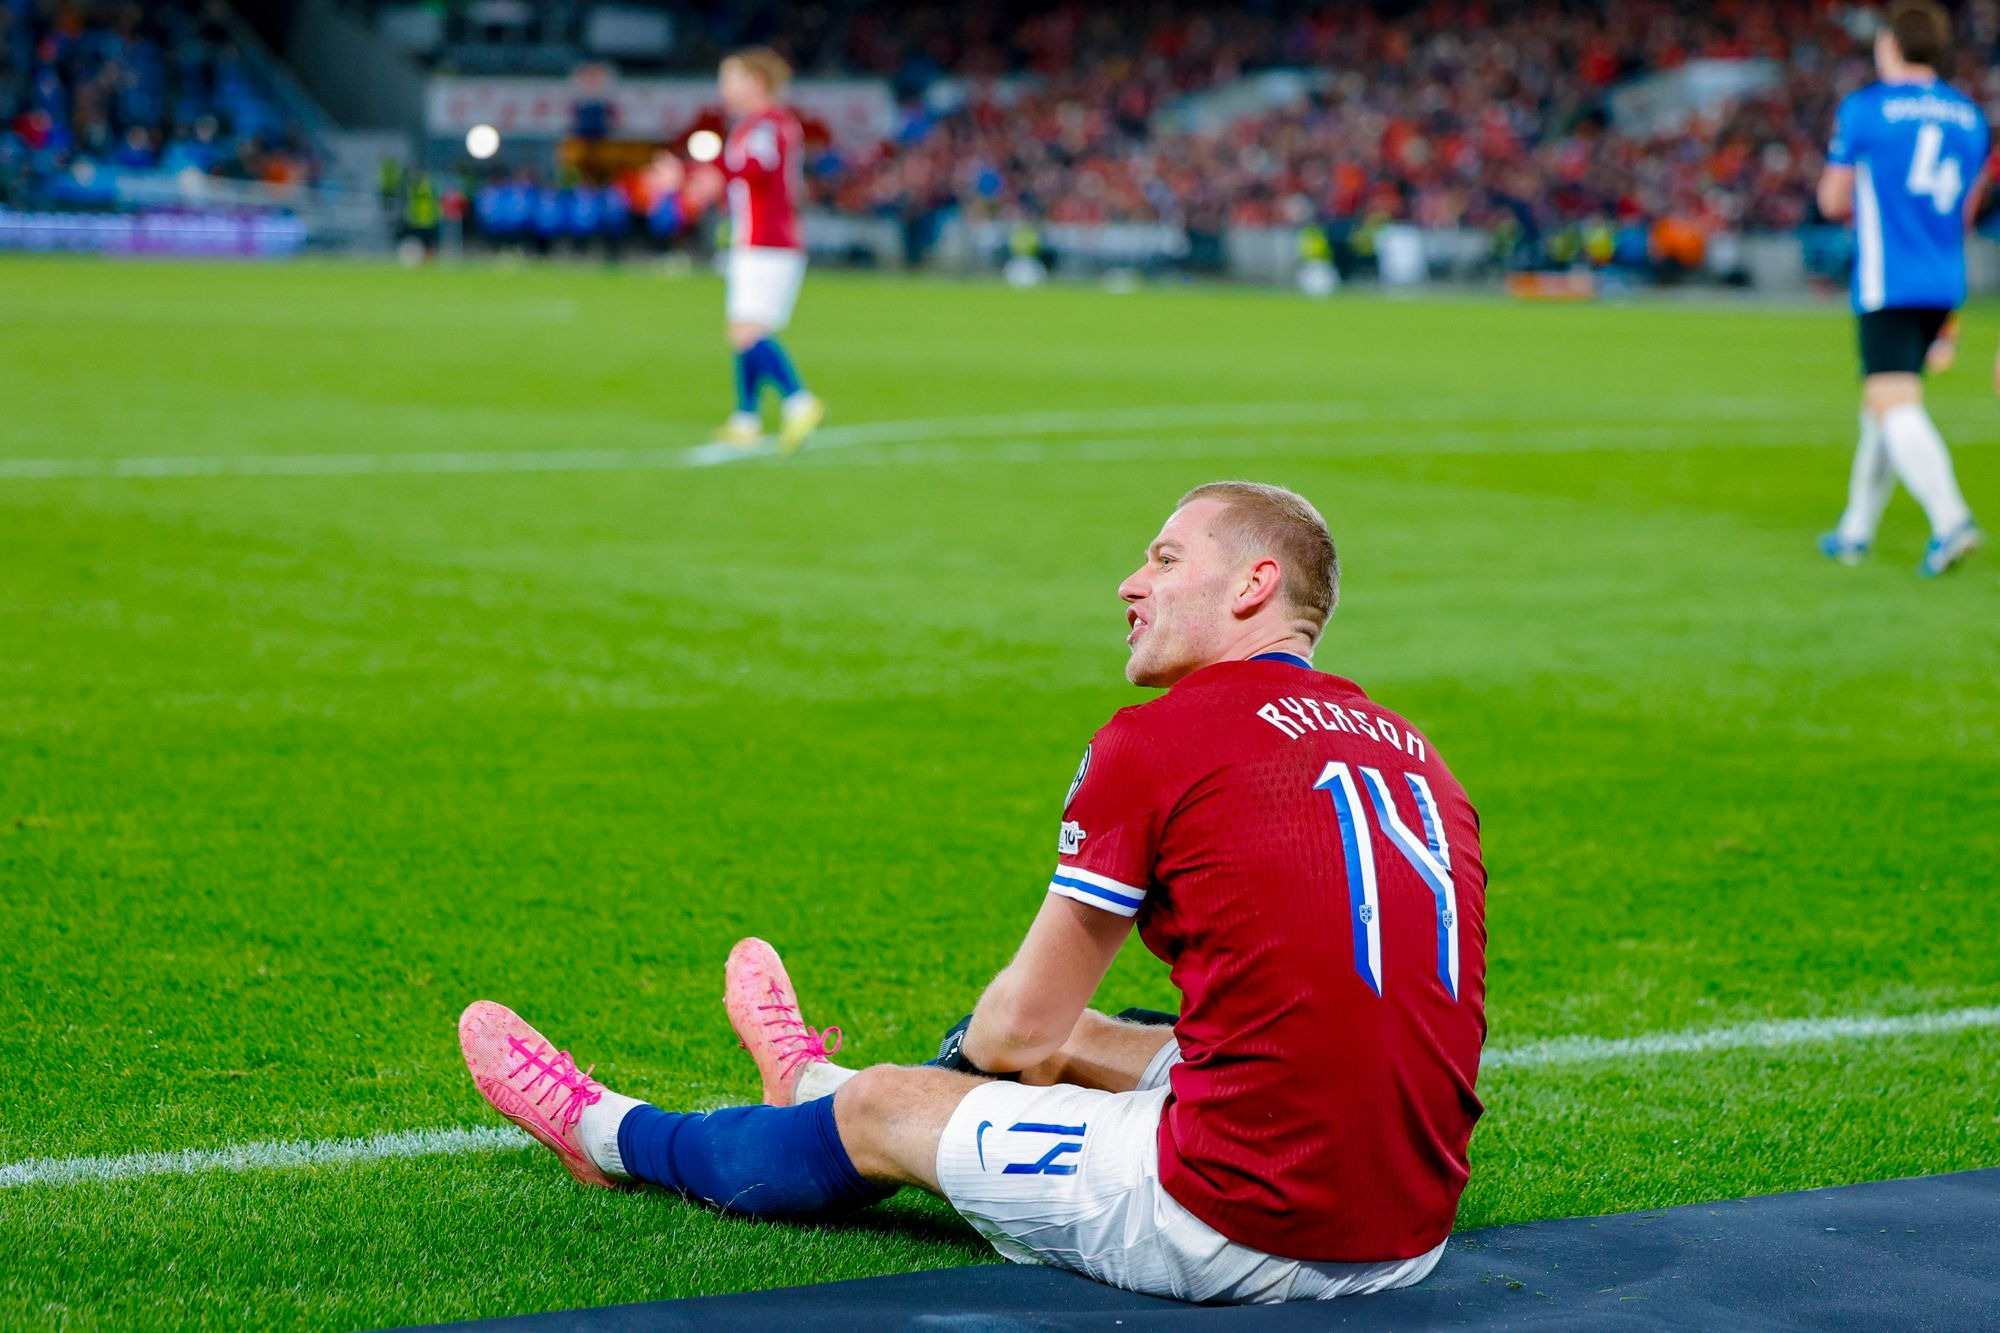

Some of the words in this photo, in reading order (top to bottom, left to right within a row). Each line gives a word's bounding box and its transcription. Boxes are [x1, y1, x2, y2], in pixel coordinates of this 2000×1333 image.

[1907, 124, 1962, 214] 4
[1256, 697, 1426, 763] RYERSON
[1313, 761, 1459, 1003] 14
[1001, 1121, 1087, 1176] 14
